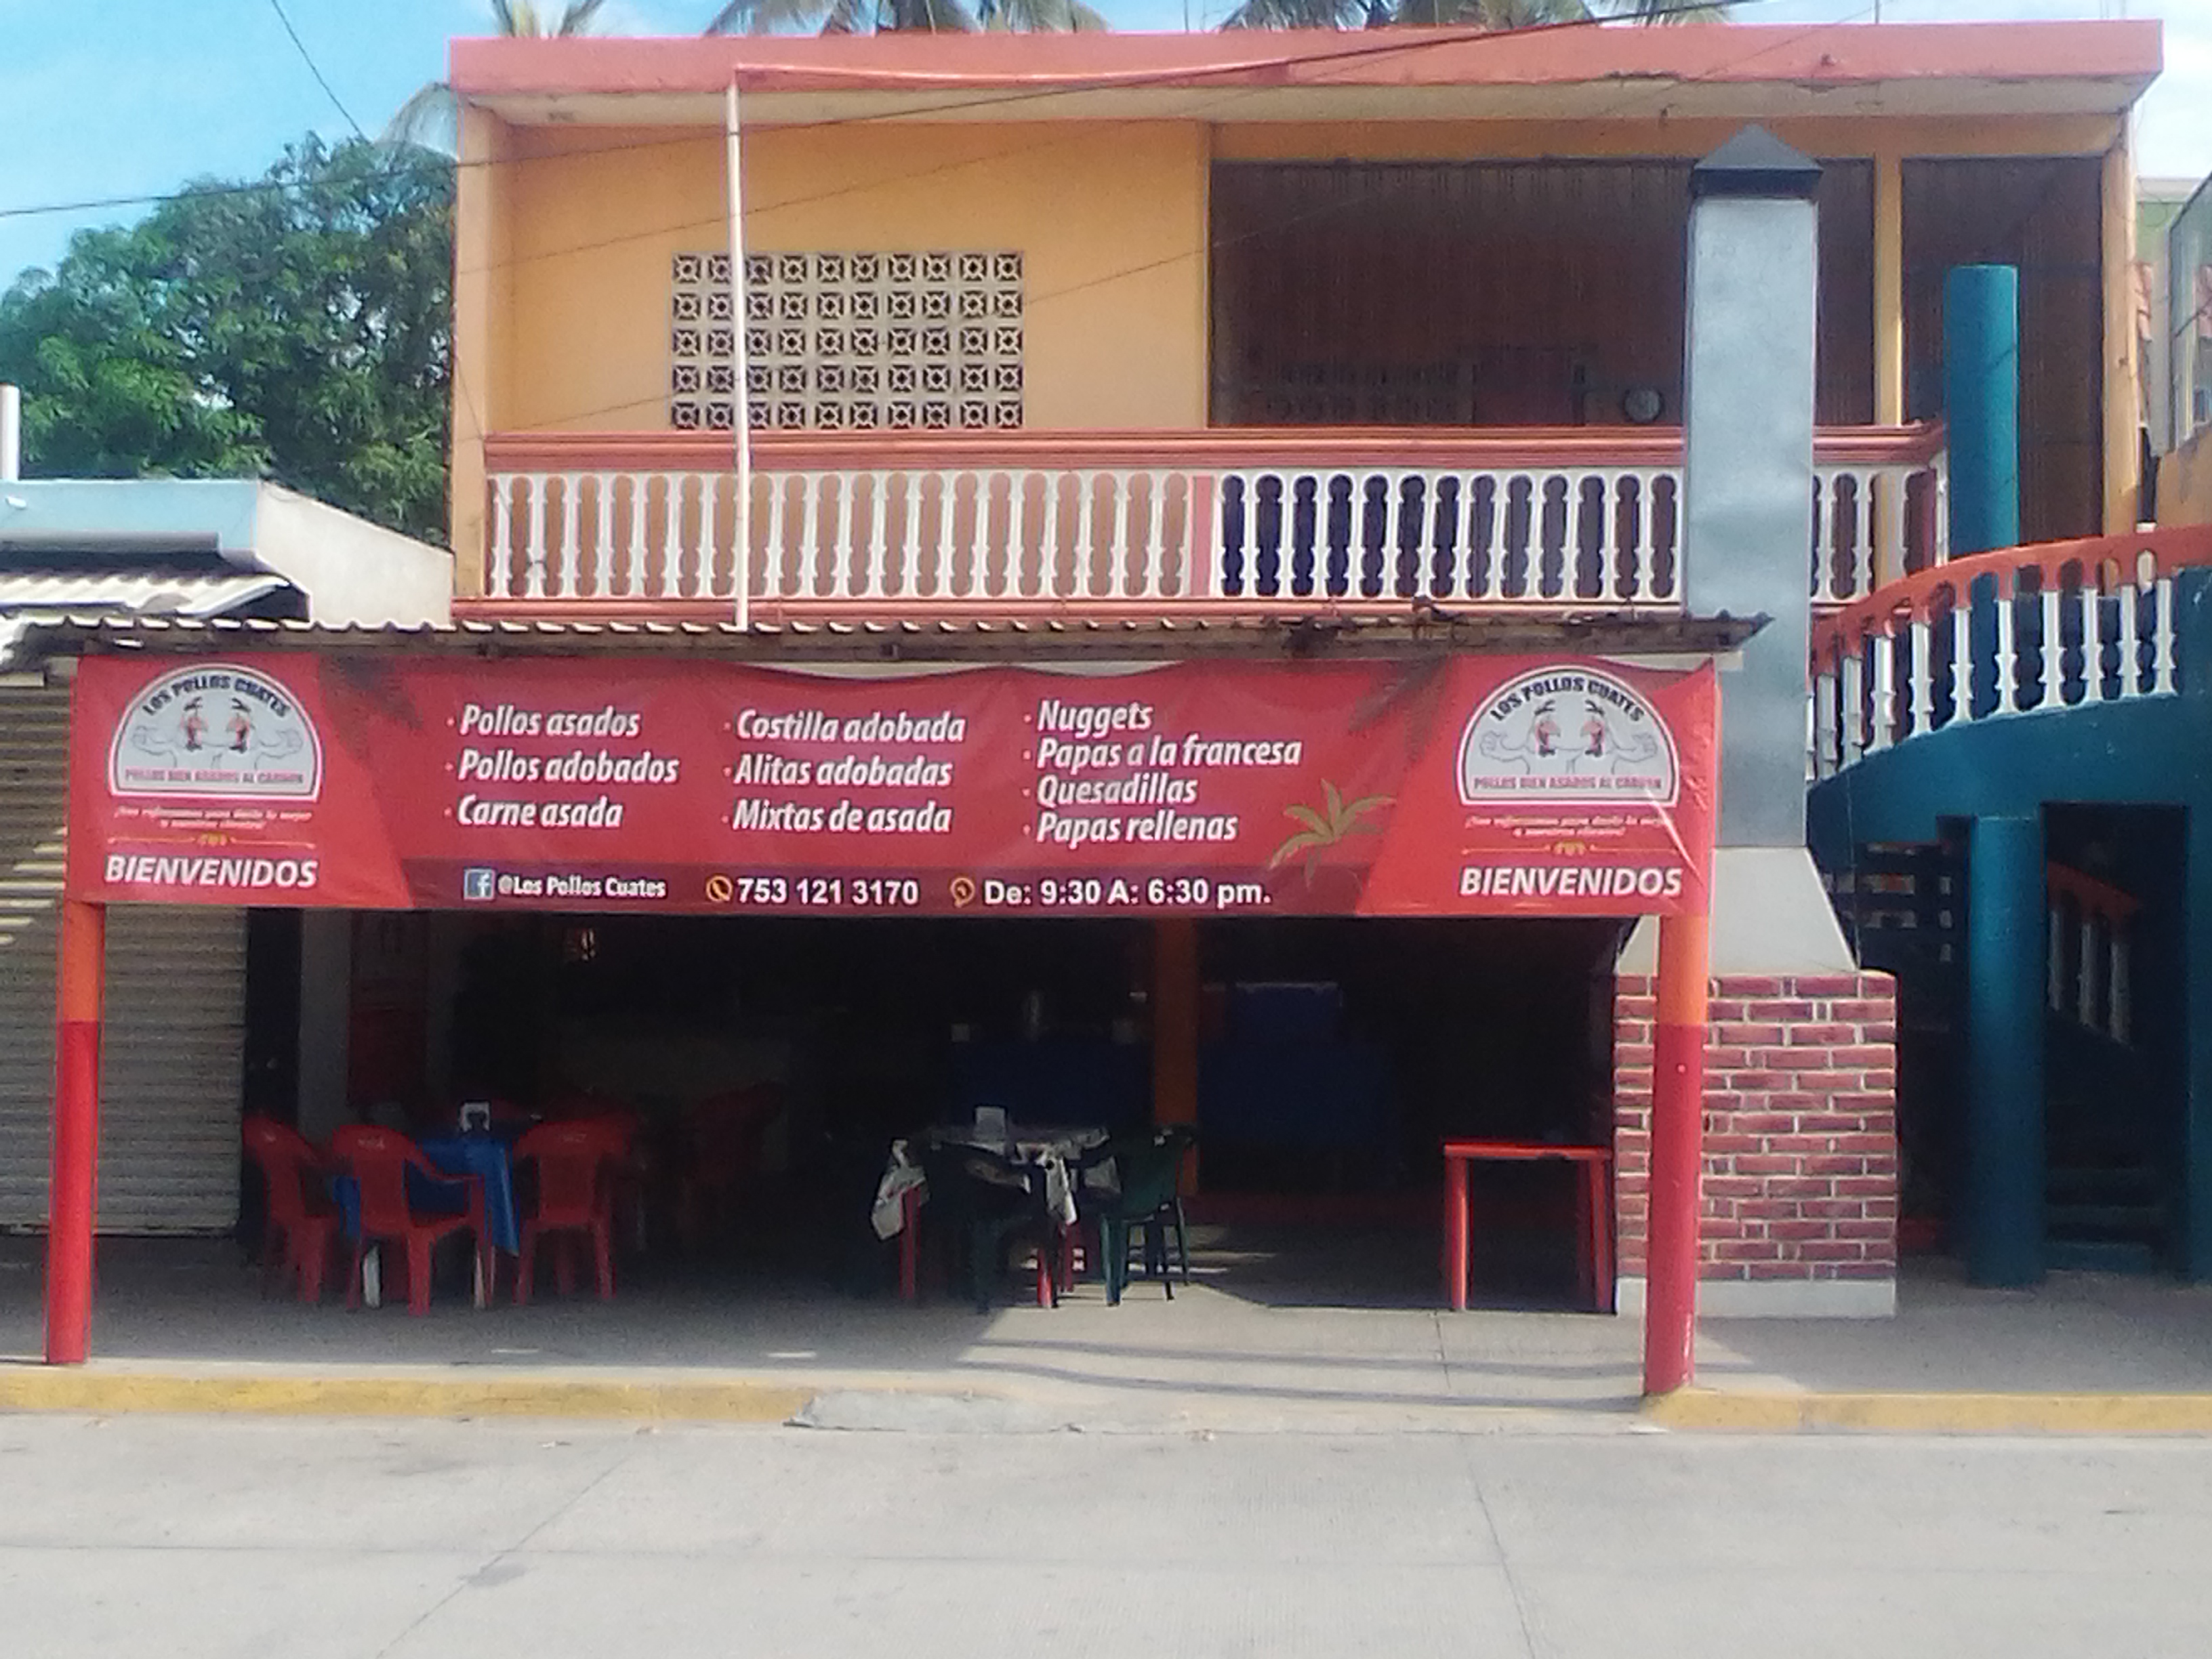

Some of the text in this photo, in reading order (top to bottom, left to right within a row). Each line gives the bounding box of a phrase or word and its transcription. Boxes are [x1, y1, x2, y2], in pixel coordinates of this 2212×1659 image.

[142, 689, 171, 716] LOS
[171, 676, 230, 696] POLLOS
[1490, 678, 1645, 721] LOS POLLOS CUATES
[459, 704, 641, 738] Pollos asados
[737, 710, 966, 743] Costilla adobada
[1038, 700, 1153, 738] Nuggets
[458, 749, 680, 783] Pollos adobados
[1037, 733, 1303, 774] Papas a la francesa
[734, 754, 953, 787] Alitas adobadas
[1038, 774, 1197, 807] Quesadillas
[457, 794, 623, 827] Carne asada
[733, 799, 951, 833] Mixtas de asada
[1036, 811, 1237, 849] Papas rellenas
[105, 855, 317, 888] BIENVENIDOS
[546, 875, 602, 896] Pollos
[605, 877, 666, 898] Cuates
[1460, 867, 1681, 897] BIENVENIDOS
[737, 878, 918, 905] 753 121 3170
[984, 880, 1271, 908] De: 9:30 A: 6:30 pm.
